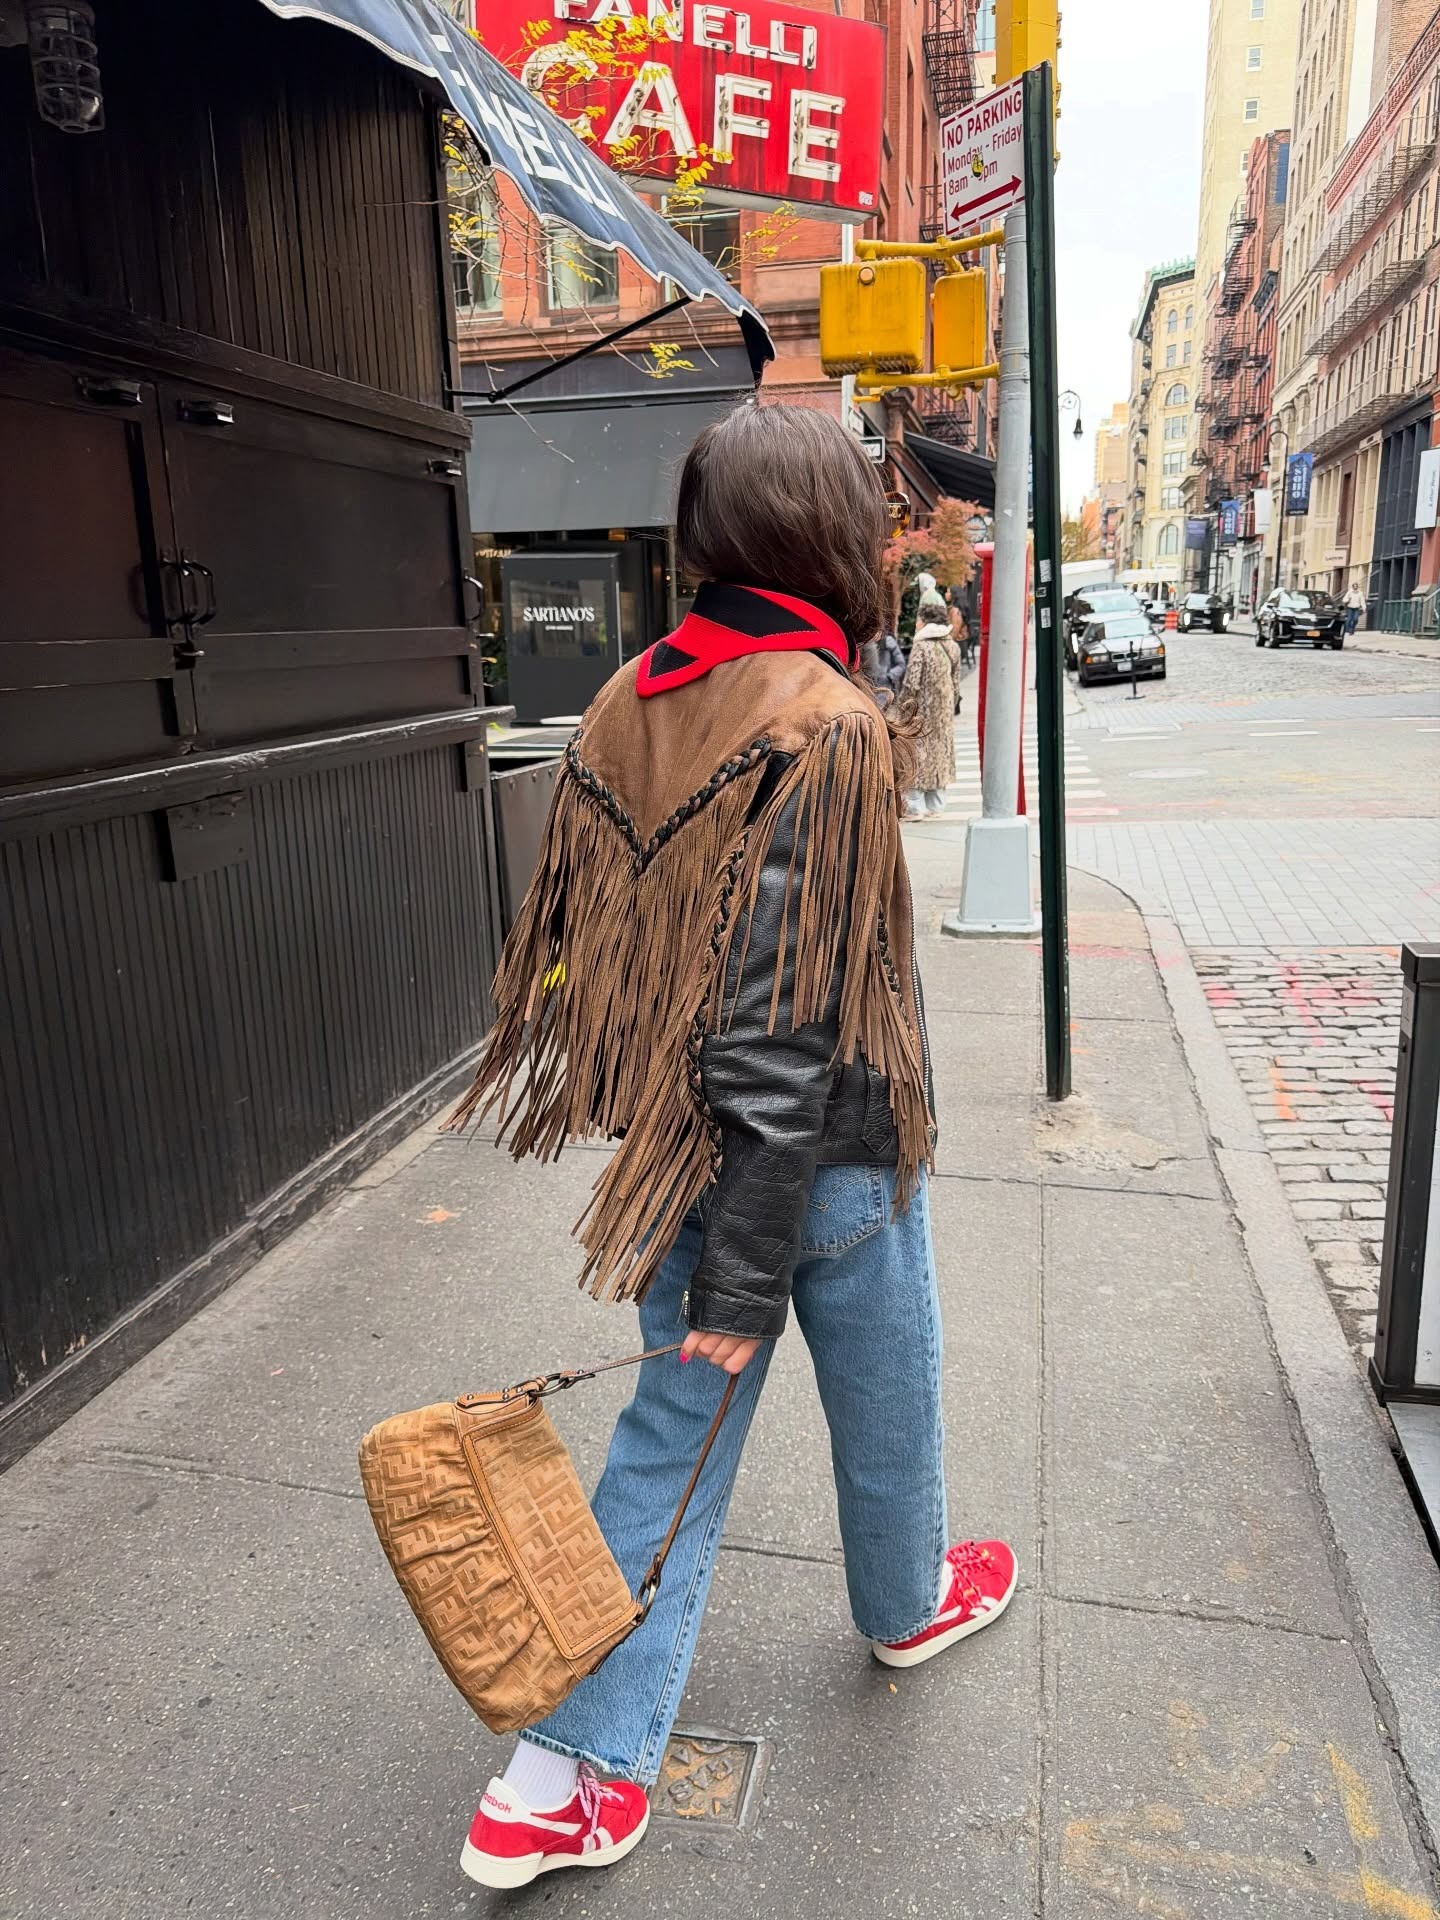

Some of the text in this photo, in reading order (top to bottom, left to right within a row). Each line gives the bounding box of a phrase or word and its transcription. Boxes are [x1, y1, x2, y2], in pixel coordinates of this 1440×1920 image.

[521, 41, 845, 182] CAFE
[947, 90, 1022, 150] NO PARKING
[992, 124, 1023, 152] Friday
[949, 175, 968, 196] 8am
[483, 1792, 512, 1814] eebok
